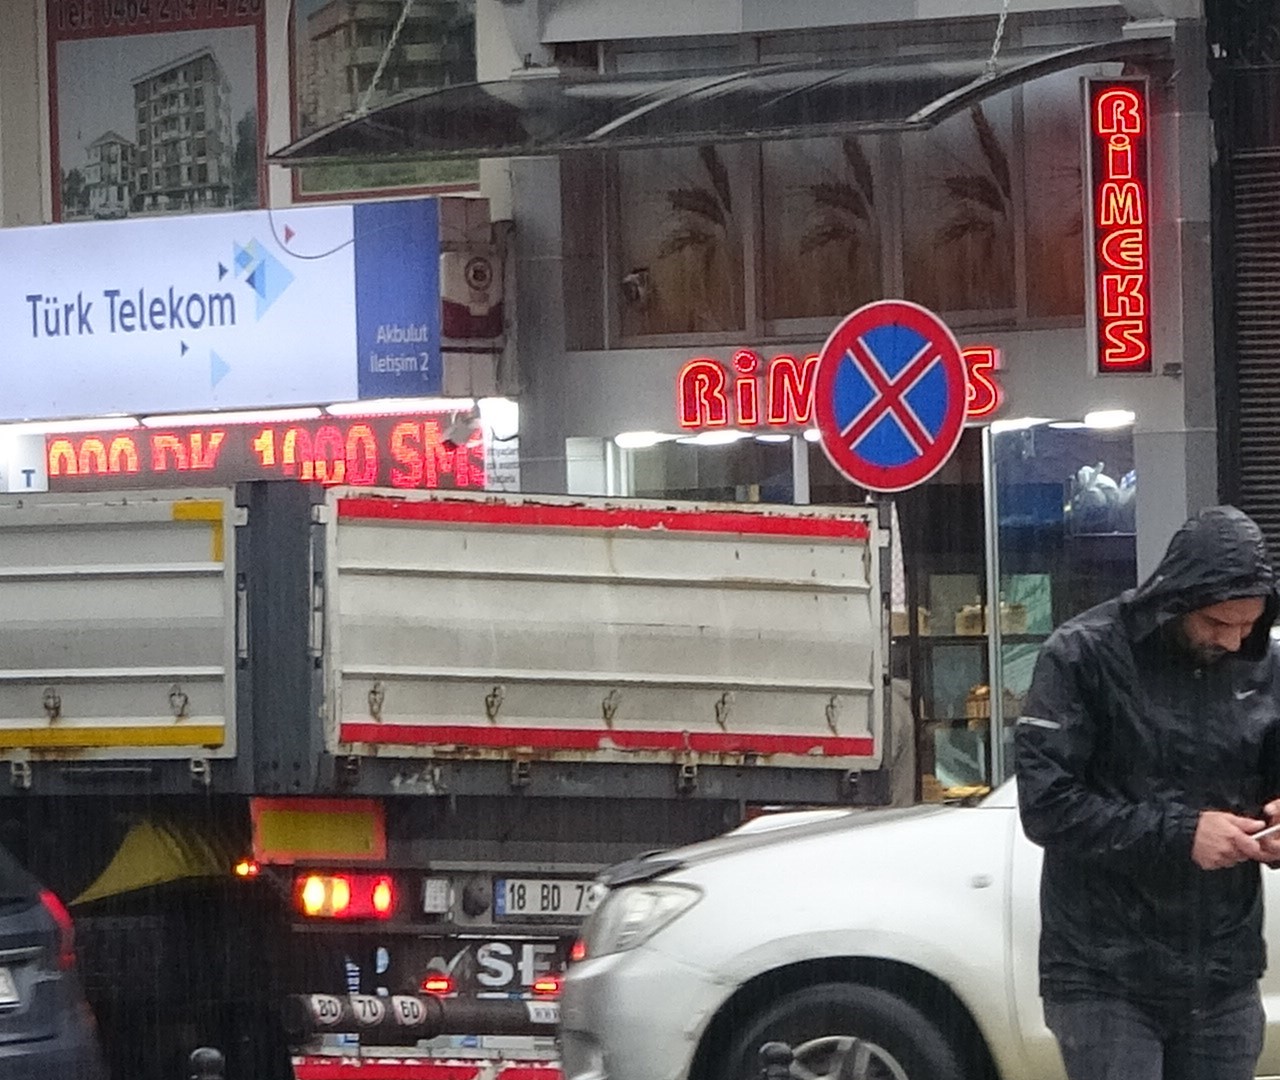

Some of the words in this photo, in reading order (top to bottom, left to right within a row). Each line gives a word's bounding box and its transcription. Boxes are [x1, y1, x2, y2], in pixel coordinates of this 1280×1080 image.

[26, 291, 95, 338] Türk
[103, 285, 236, 333] Telekom
[376, 322, 429, 344] Akbulut
[420, 351, 430, 372] 2
[509, 884, 526, 910] 18
[541, 884, 560, 912] BD
[358, 999, 379, 1018] 70
